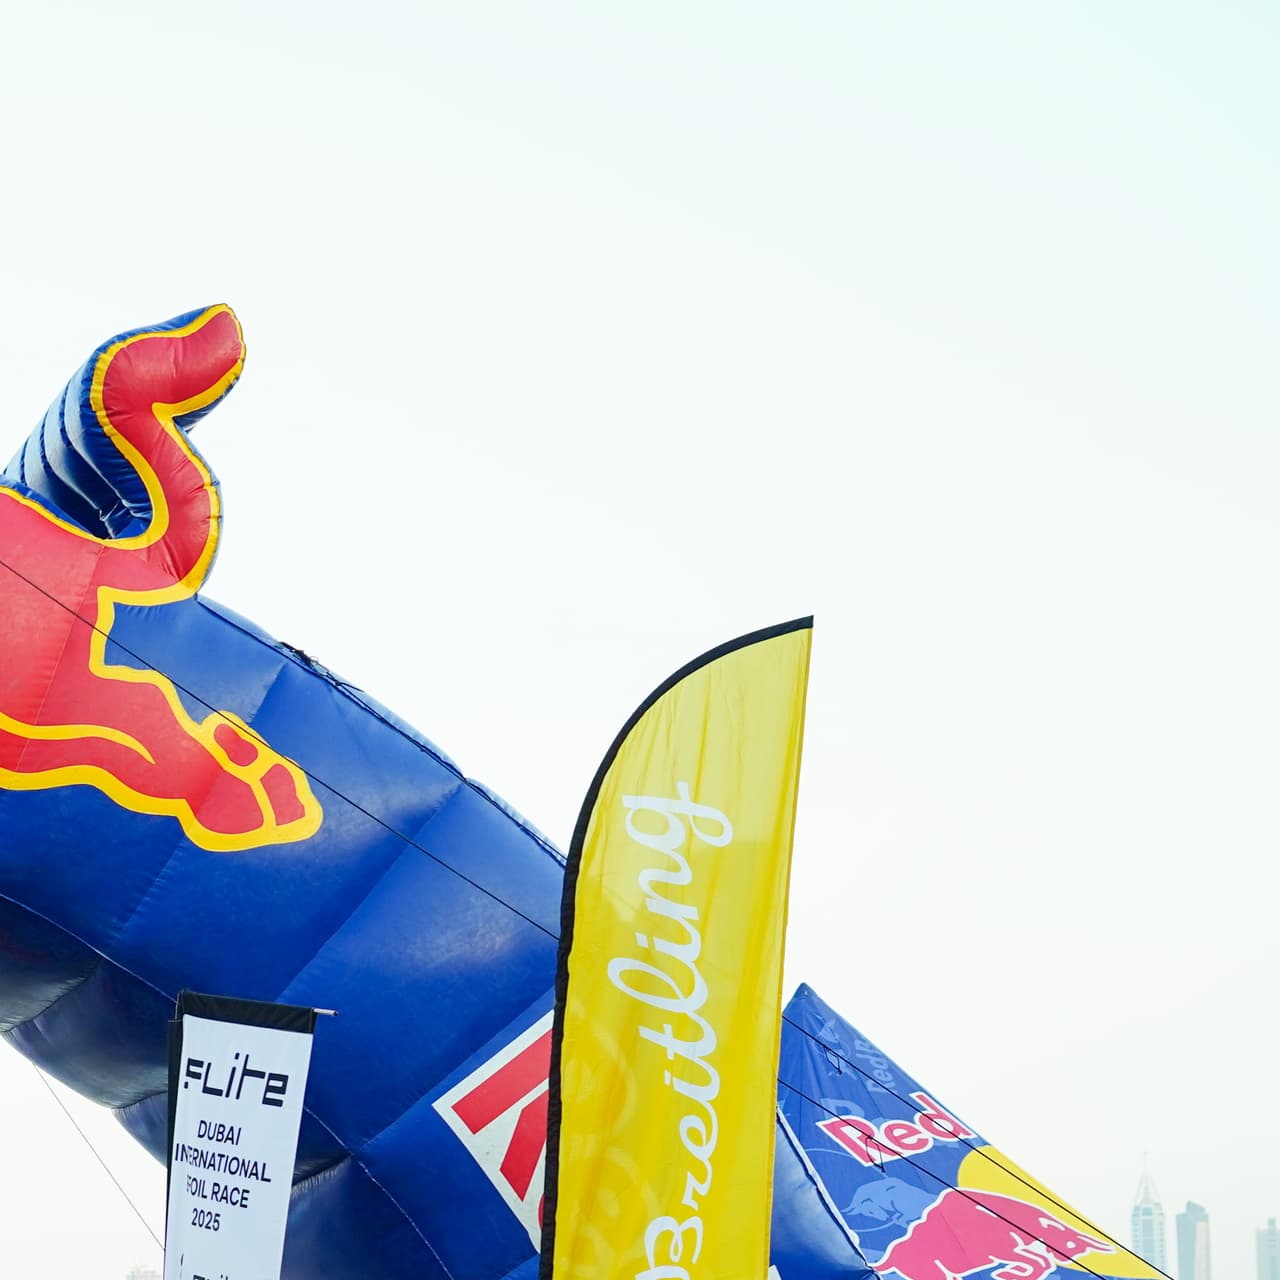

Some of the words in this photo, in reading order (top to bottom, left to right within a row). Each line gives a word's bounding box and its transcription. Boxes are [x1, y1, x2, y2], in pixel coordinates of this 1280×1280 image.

[197, 1120, 242, 1147] DUBAI
[816, 1090, 977, 1167] Red
[209, 1181, 251, 1209] RACE
[191, 1208, 222, 1233] 2025
